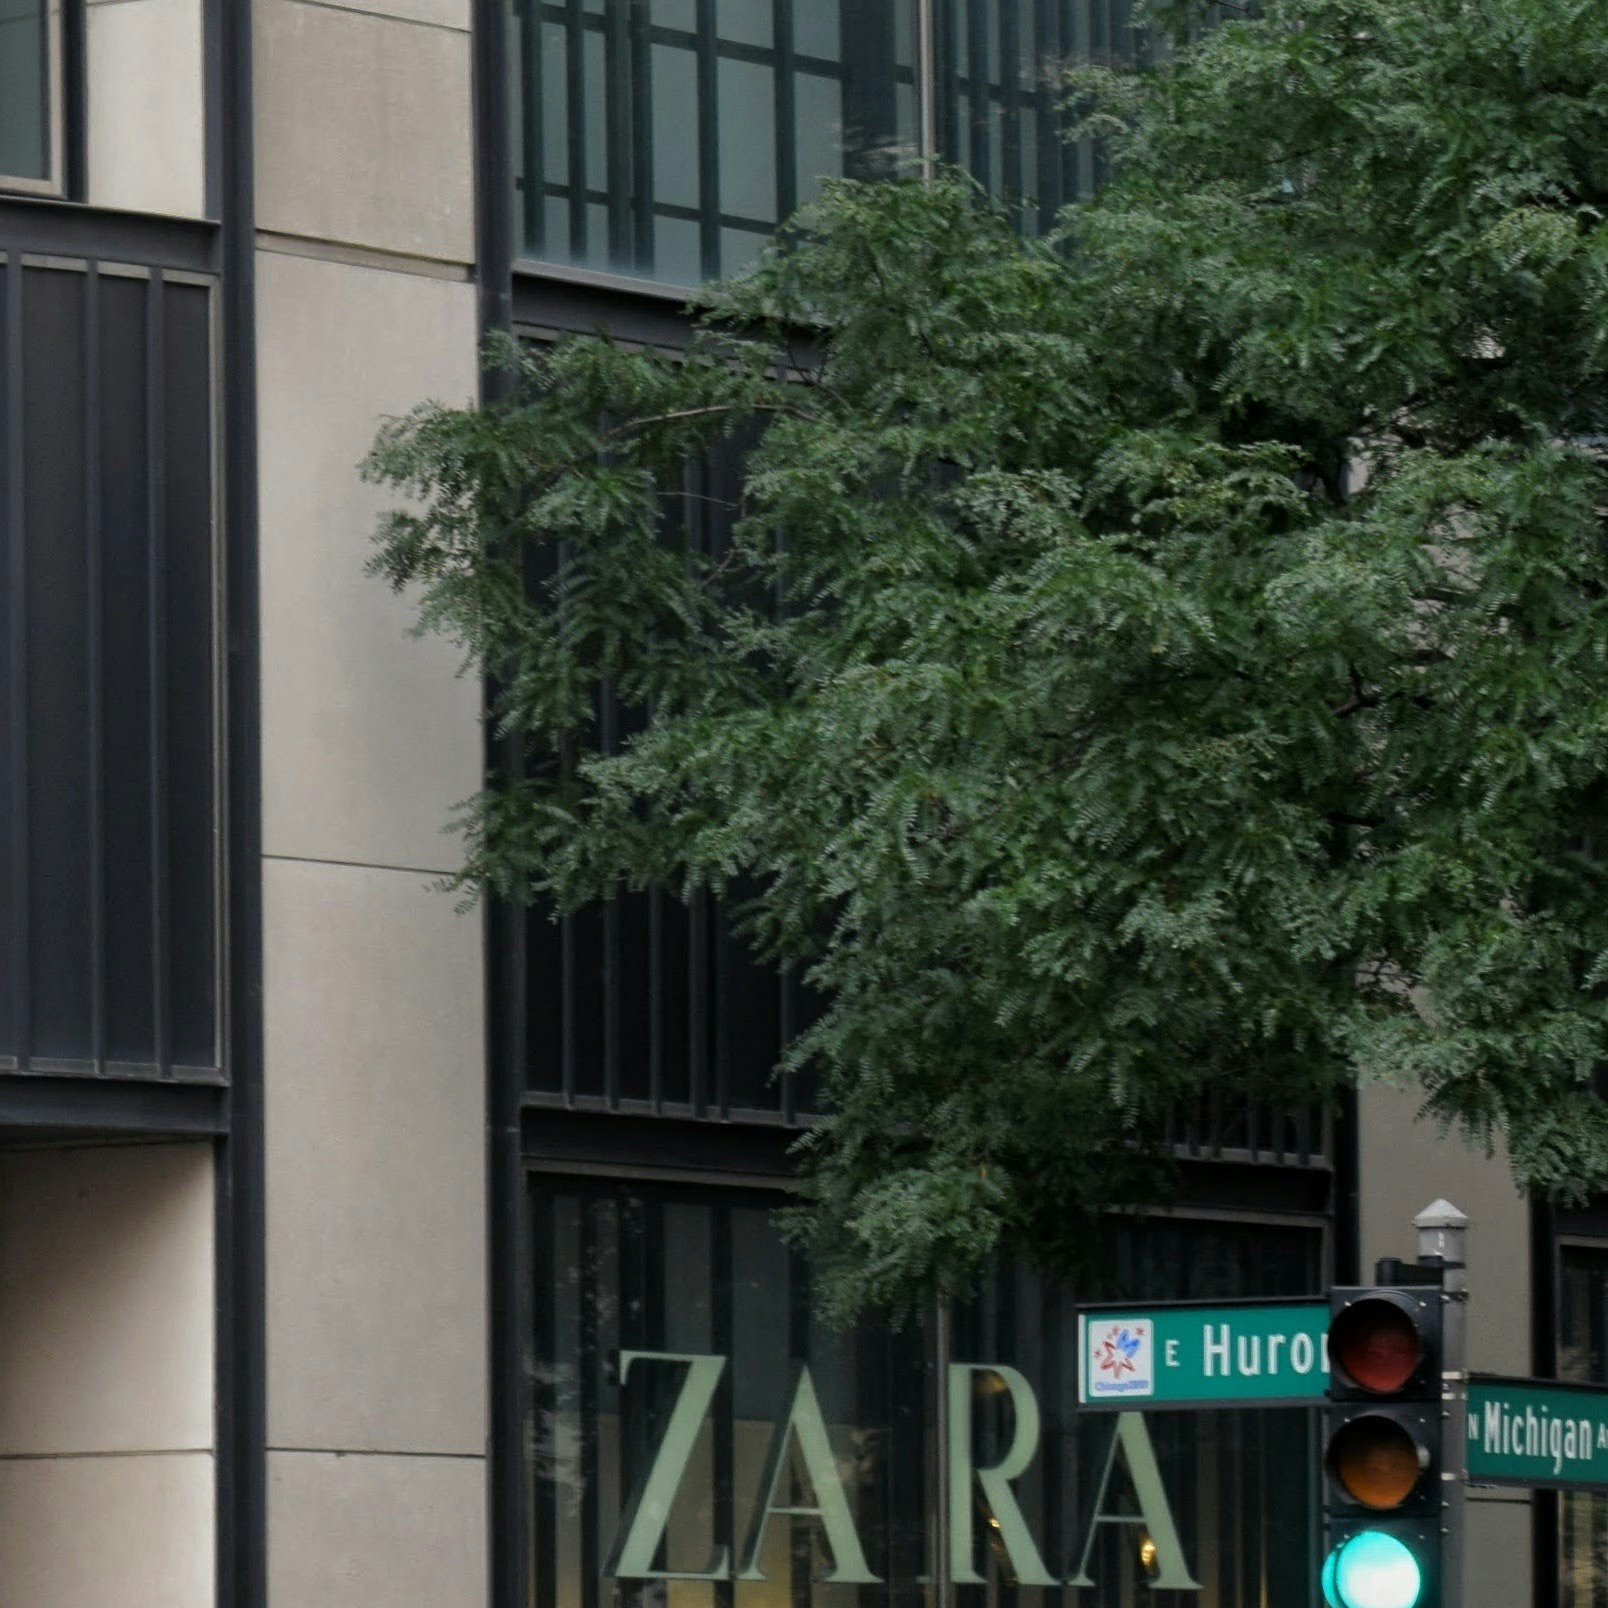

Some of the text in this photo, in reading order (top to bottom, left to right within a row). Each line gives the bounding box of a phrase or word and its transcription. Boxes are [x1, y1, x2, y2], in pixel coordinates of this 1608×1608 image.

[1165, 1339, 1180, 1367] E
[610, 1350, 1204, 1591] ZARA
[1468, 1400, 1608, 1475] N Michigan A
